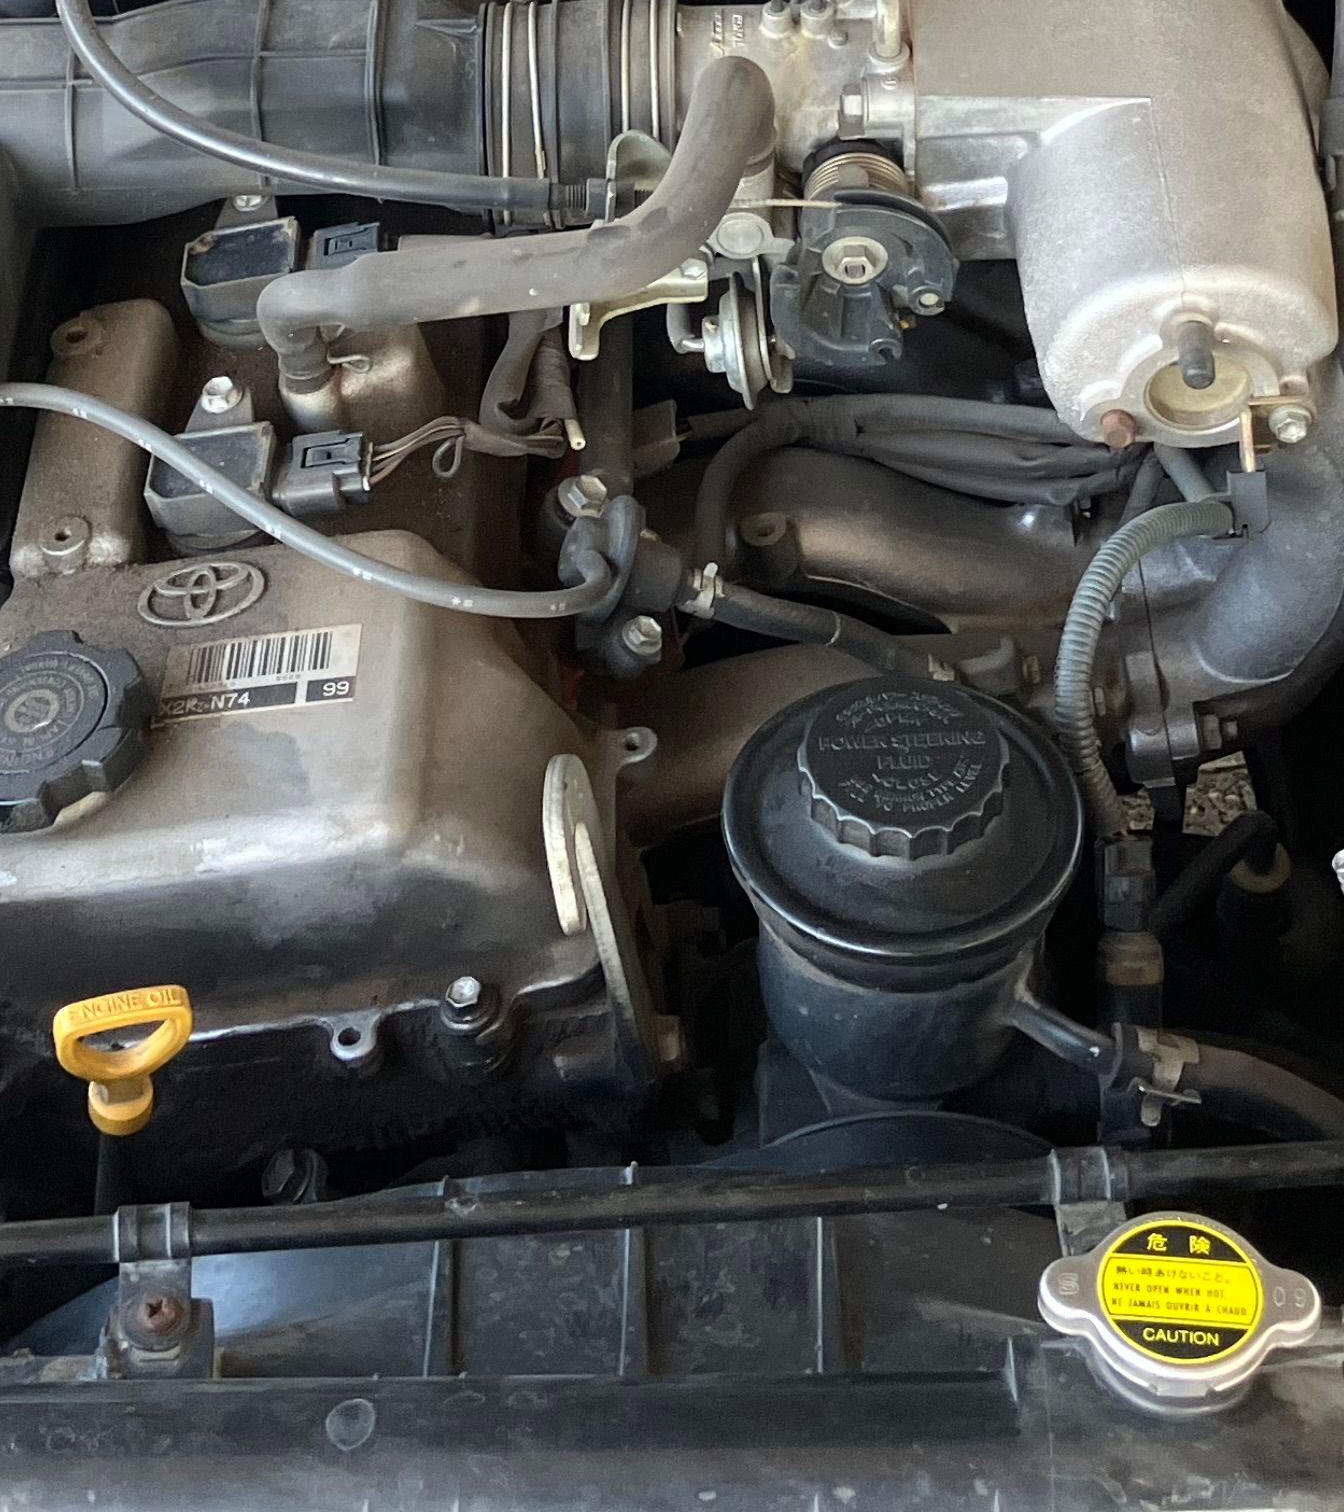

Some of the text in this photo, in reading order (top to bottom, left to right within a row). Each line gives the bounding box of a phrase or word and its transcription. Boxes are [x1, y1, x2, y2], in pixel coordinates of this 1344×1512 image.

[322, 680, 349, 696] 99
[818, 730, 987, 752] POWER STEERING
[877, 754, 930, 770] FLUID
[147, 988, 182, 1007] OIL
[1113, 1282, 1141, 1292] NEVER
[1146, 1284, 1169, 1294] OPEN
[1176, 1286, 1201, 1296] WHEN
[1128, 1299, 1161, 1310] JAMAIS
[1166, 1301, 1200, 1312] OUVRIR
[1142, 1326, 1220, 1347] CAUTION
